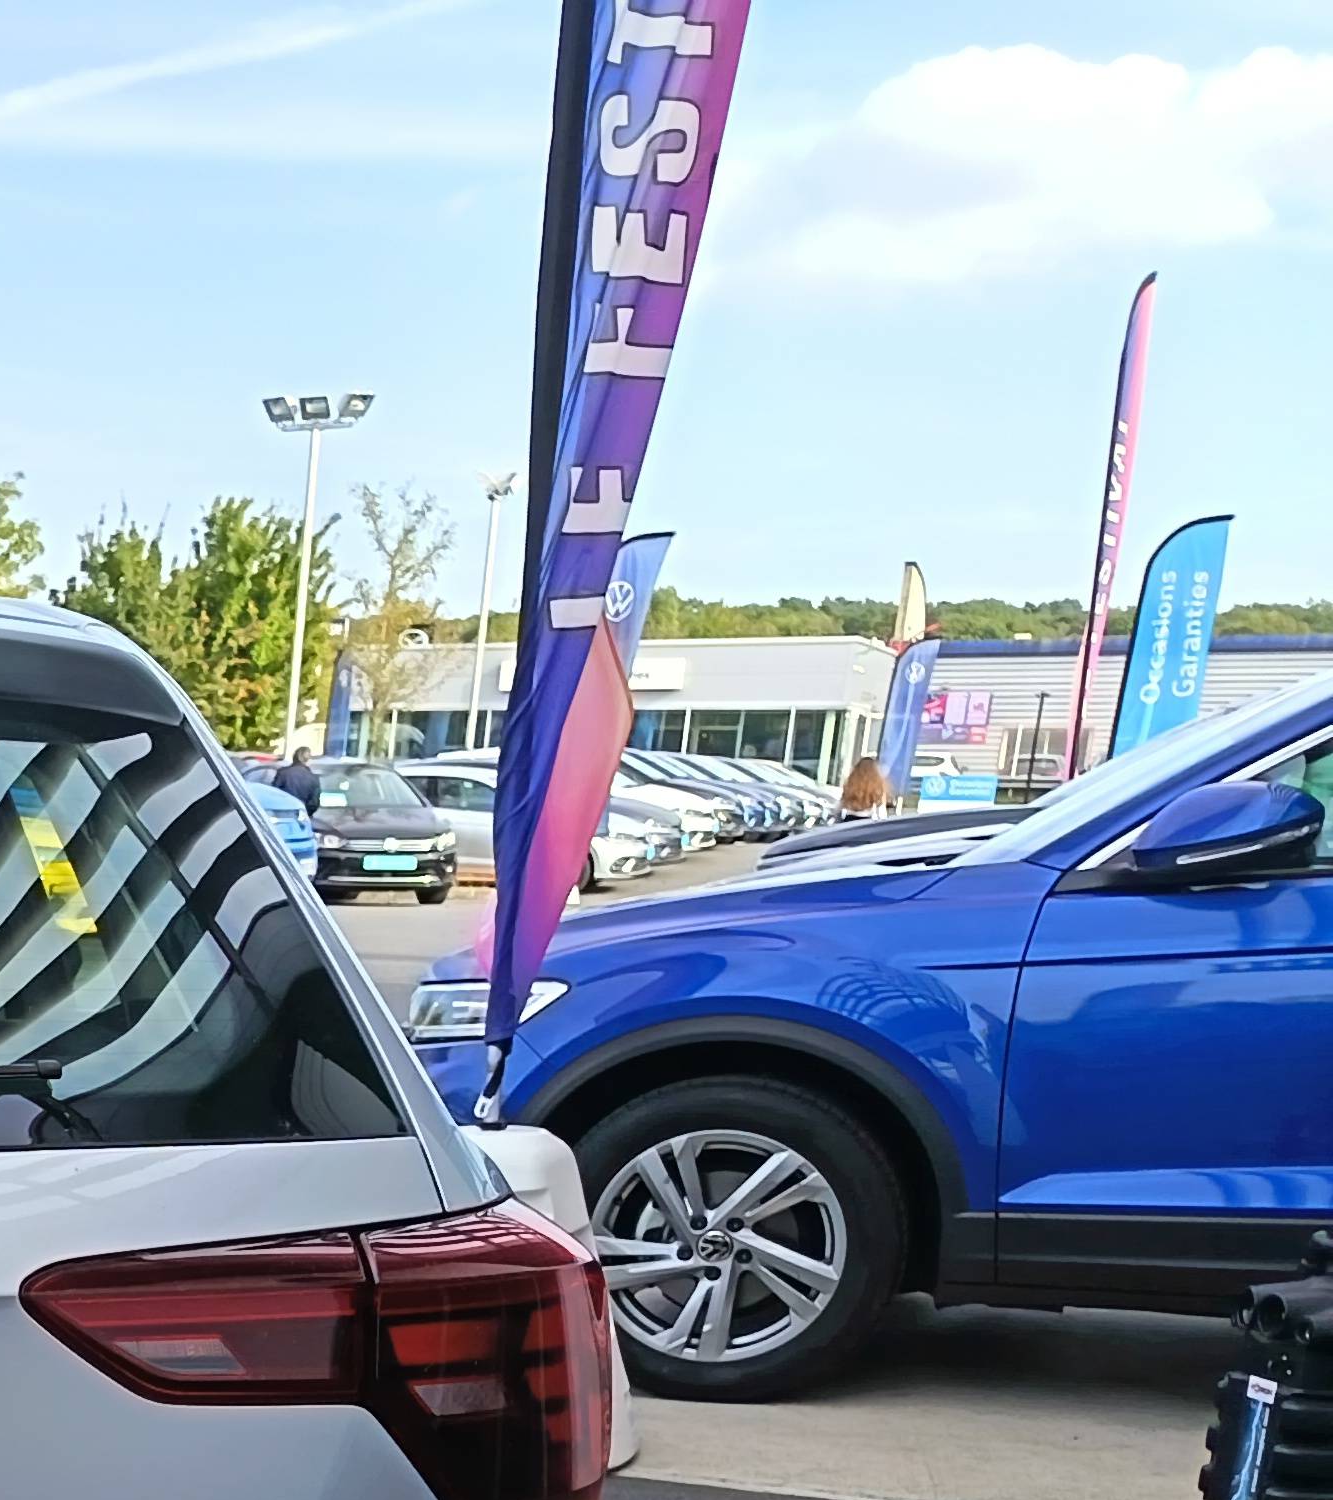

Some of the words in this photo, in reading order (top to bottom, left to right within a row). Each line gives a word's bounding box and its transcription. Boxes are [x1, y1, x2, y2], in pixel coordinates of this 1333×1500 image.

[604, 581, 634, 622] VW
[1139, 568, 1178, 704] Occasions
[1171, 570, 1209, 698] Garanties
